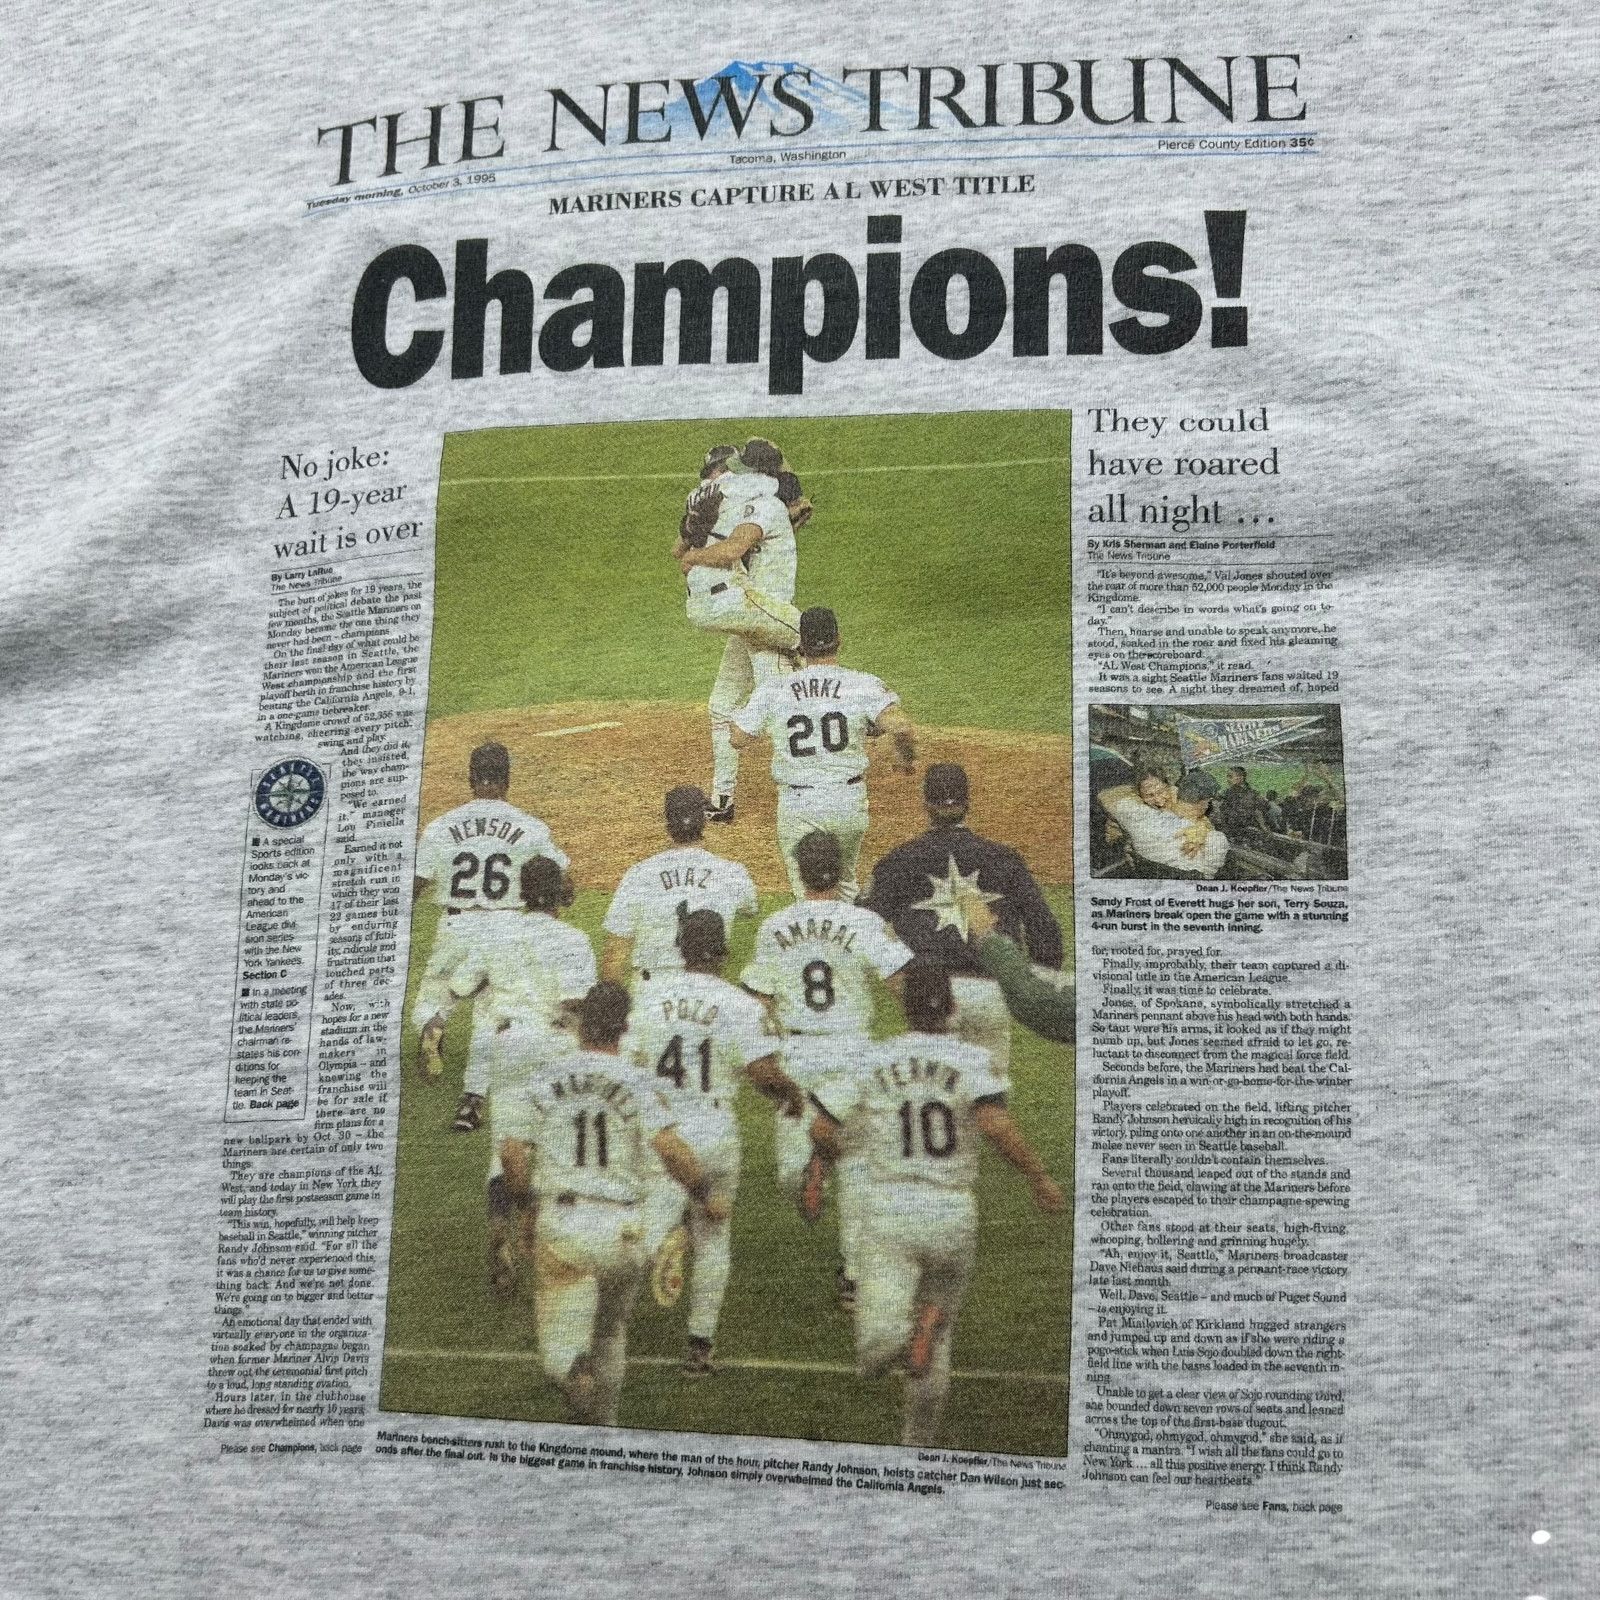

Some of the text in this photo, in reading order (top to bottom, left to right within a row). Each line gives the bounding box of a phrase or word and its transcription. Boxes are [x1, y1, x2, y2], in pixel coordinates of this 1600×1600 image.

[317, 54, 1307, 186] THE NEWS TRIBUNE
[1158, 136, 1315, 151] Pierce County Edition 35¢
[729, 149, 847, 165] Tacoma, Washington
[307, 173, 496, 210] Tuesday morning, October 3, 1995
[548, 174, 1035, 216] MARINERS CAPTURE AL WEST TITLE
[351, 209, 1248, 395] Champions!
[1088, 407, 1269, 438] They could
[281, 446, 389, 481] No joke:
[1088, 447, 1280, 476] have roared
[276, 483, 408, 520] A 19-year
[1088, 493, 1128, 523] all
[1140, 494, 1223, 532] night
[274, 520, 423, 559] wait is over
[1088, 540, 1099, 550] By
[1103, 540, 1120, 548] Kris
[1124, 540, 1165, 549] Sherman
[1169, 541, 1186, 550] and
[1222, 541, 1275, 549] Porterfield
[1108, 551, 1133, 560] News
[1137, 552, 1170, 560] Tribune
[271, 574, 282, 582] By
[285, 572, 305, 580] Larry
[289, 581, 310, 590] News
[1120, 569, 1154, 580] beyond
[1215, 571, 1231, 580] Val
[1233, 571, 1263, 581] Jones
[1266, 570, 1307, 580] shouted
[1310, 570, 1333, 579] over
[790, 678, 842, 700] PIRKL
[787, 711, 849, 758] 20
[251, 848, 315, 859] Sports edition
[272, 835, 304, 846] special
[451, 851, 511, 899] 26
[659, 868, 712, 891] DIAZ
[1196, 884, 1219, 892] Dean
[1090, 897, 1348, 910] Sandy Frost of Everett hugs her son, Terry Souza,
[1106, 909, 1151, 918] Mariners
[1154, 910, 1182, 919] break
[1186, 912, 1211, 920] open
[1214, 910, 1232, 920] the
[1234, 912, 1264, 922] game
[1267, 911, 1290, 920] with
[1302, 911, 1349, 922] stunning
[773, 917, 859, 953] AMARAL
[1091, 921, 1263, 933] 4-run burst in the seventh inning.
[243, 969, 287, 979] Section C
[802, 960, 835, 1012] 8
[656, 1034, 712, 1093] 41
[1102, 1061, 1352, 1073] Seconds before, the Mariners had beat the Cal-
[573, 1109, 608, 1168] 11
[900, 1100, 957, 1158] 10
[230, 1171, 256, 1181] They
[279, 1168, 331, 1179] champions
[336, 1167, 346, 1176] of
[348, 1167, 363, 1175] the
[376, 1445, 397, 1454] onds
[401, 1446, 422, 1456] after
[426, 1448, 441, 1457] the
[445, 1449, 464, 1459] final
[467, 1451, 485, 1461] out.
[501, 1452, 516, 1463] the
[519, 1455, 555, 1467] biggest
[558, 1458, 585, 1469] game
[588, 1459, 597, 1469] in
[600, 1460, 645, 1472] franchise
[648, 1464, 683, 1477] history,
[687, 1466, 727, 1478] Johnson
[730, 1470, 762, 1482] simply
[766, 1473, 832, 1486] overwhelmed
[836, 1477, 852, 1488] the
[856, 1478, 904, 1492] California
[907, 1482, 945, 1495] Angels.
[377, 1431, 418, 1443] Mariners
[421, 1434, 482, 1448] bench-sitters
[484, 1440, 505, 1449] rush
[520, 1442, 536, 1450] the
[539, 1442, 587, 1456] Kingdome
[590, 1448, 626, 1459] mound,
[629, 1450, 658, 1460] where
[662, 1452, 677, 1461] the
[681, 1454, 701, 1463] man
[705, 1455, 715, 1464] of
[717, 1456, 733, 1465] the
[737, 1456, 760, 1467] hour,
[763, 1458, 799, 1470] pitcher
[802, 1461, 833, 1474] Randy
[836, 1463, 879, 1477] Johnson,
[884, 1467, 915, 1479] hoists
[917, 1470, 957, 1481] catcher
[960, 1472, 980, 1483] Dan
[984, 1474, 1018, 1486] Wilson
[1021, 1476, 1041, 1489] just
[1044, 1480, 1066, 1490] sec-
[1206, 1500, 1342, 1514] Please see Fans, back page
